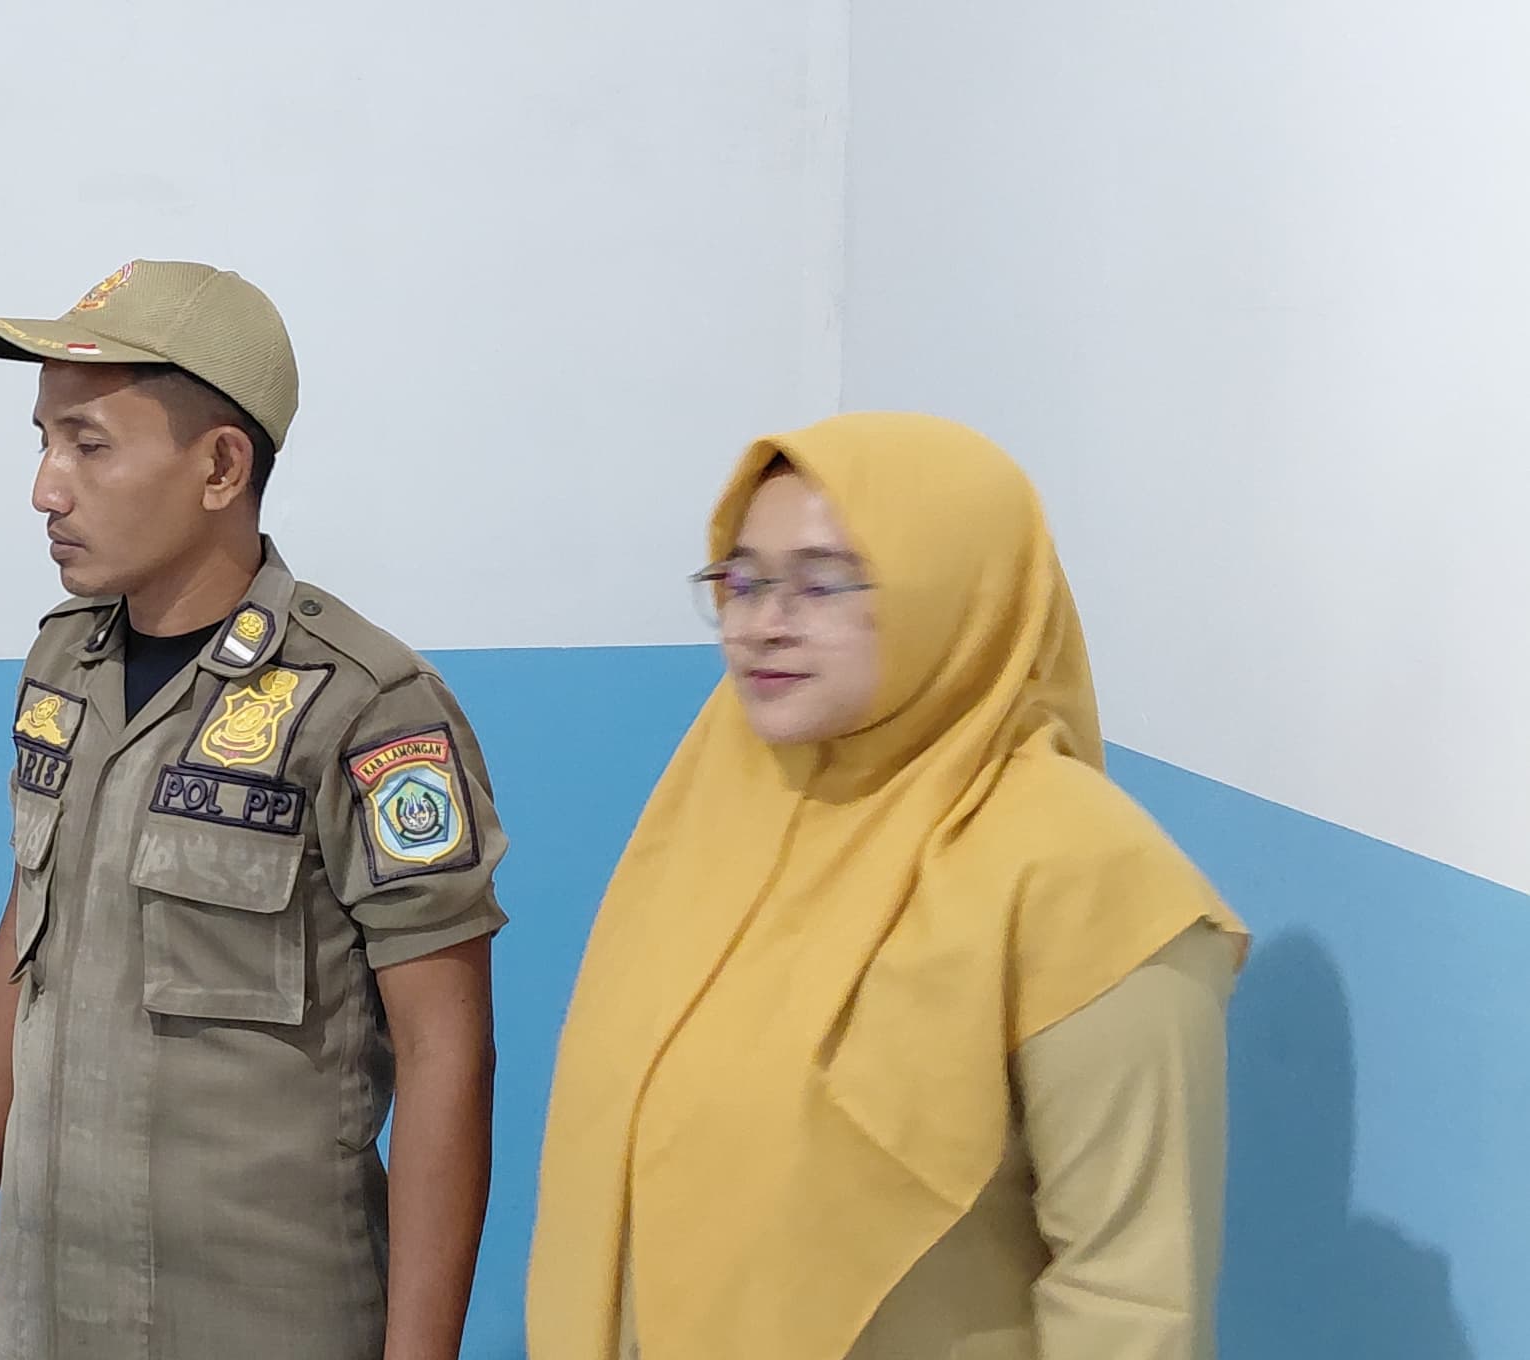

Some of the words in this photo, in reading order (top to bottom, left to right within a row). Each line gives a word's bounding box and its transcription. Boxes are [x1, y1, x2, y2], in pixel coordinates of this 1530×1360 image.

[386, 743, 442, 764] LAMONGAN
[163, 773, 223, 815] POL
[242, 787, 292, 824] PP
